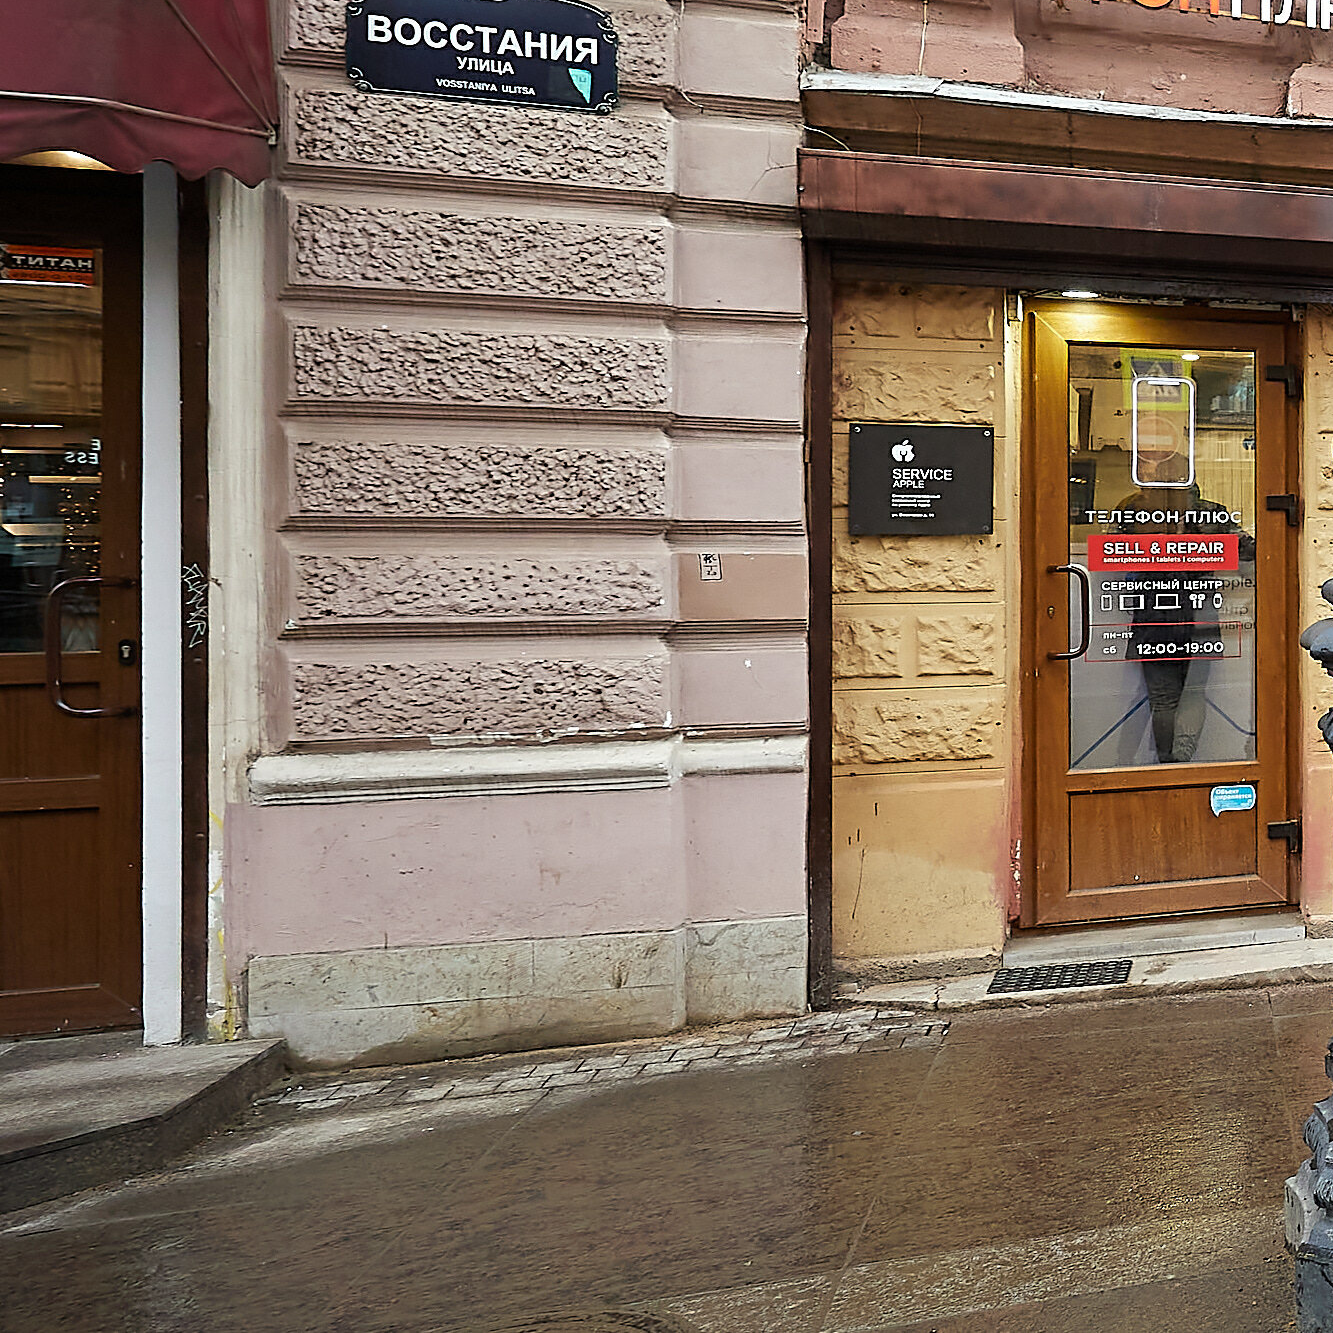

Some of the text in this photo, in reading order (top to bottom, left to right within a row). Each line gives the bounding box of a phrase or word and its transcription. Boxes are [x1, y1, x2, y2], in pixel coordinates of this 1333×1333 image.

[366, 14, 599, 65] ВОССТАНИЯ
[456, 56, 515, 76] УЛИЦА
[435, 78, 536, 97] VOSSTANIYA ULITSA
[11, 255, 93, 268] ТИТАН
[892, 468, 953, 481] SERVICE
[892, 480, 925, 489] APPLE
[1085, 510, 1242, 524] ТЕЛЕФОН ПЛЮС
[1103, 542, 1224, 555] SELL & REPAIR
[1101, 578, 1223, 591] СЕРВИСНЫЙ ЦЕНТР
[1102, 641, 1224, 655] сб 12:00-19:00
